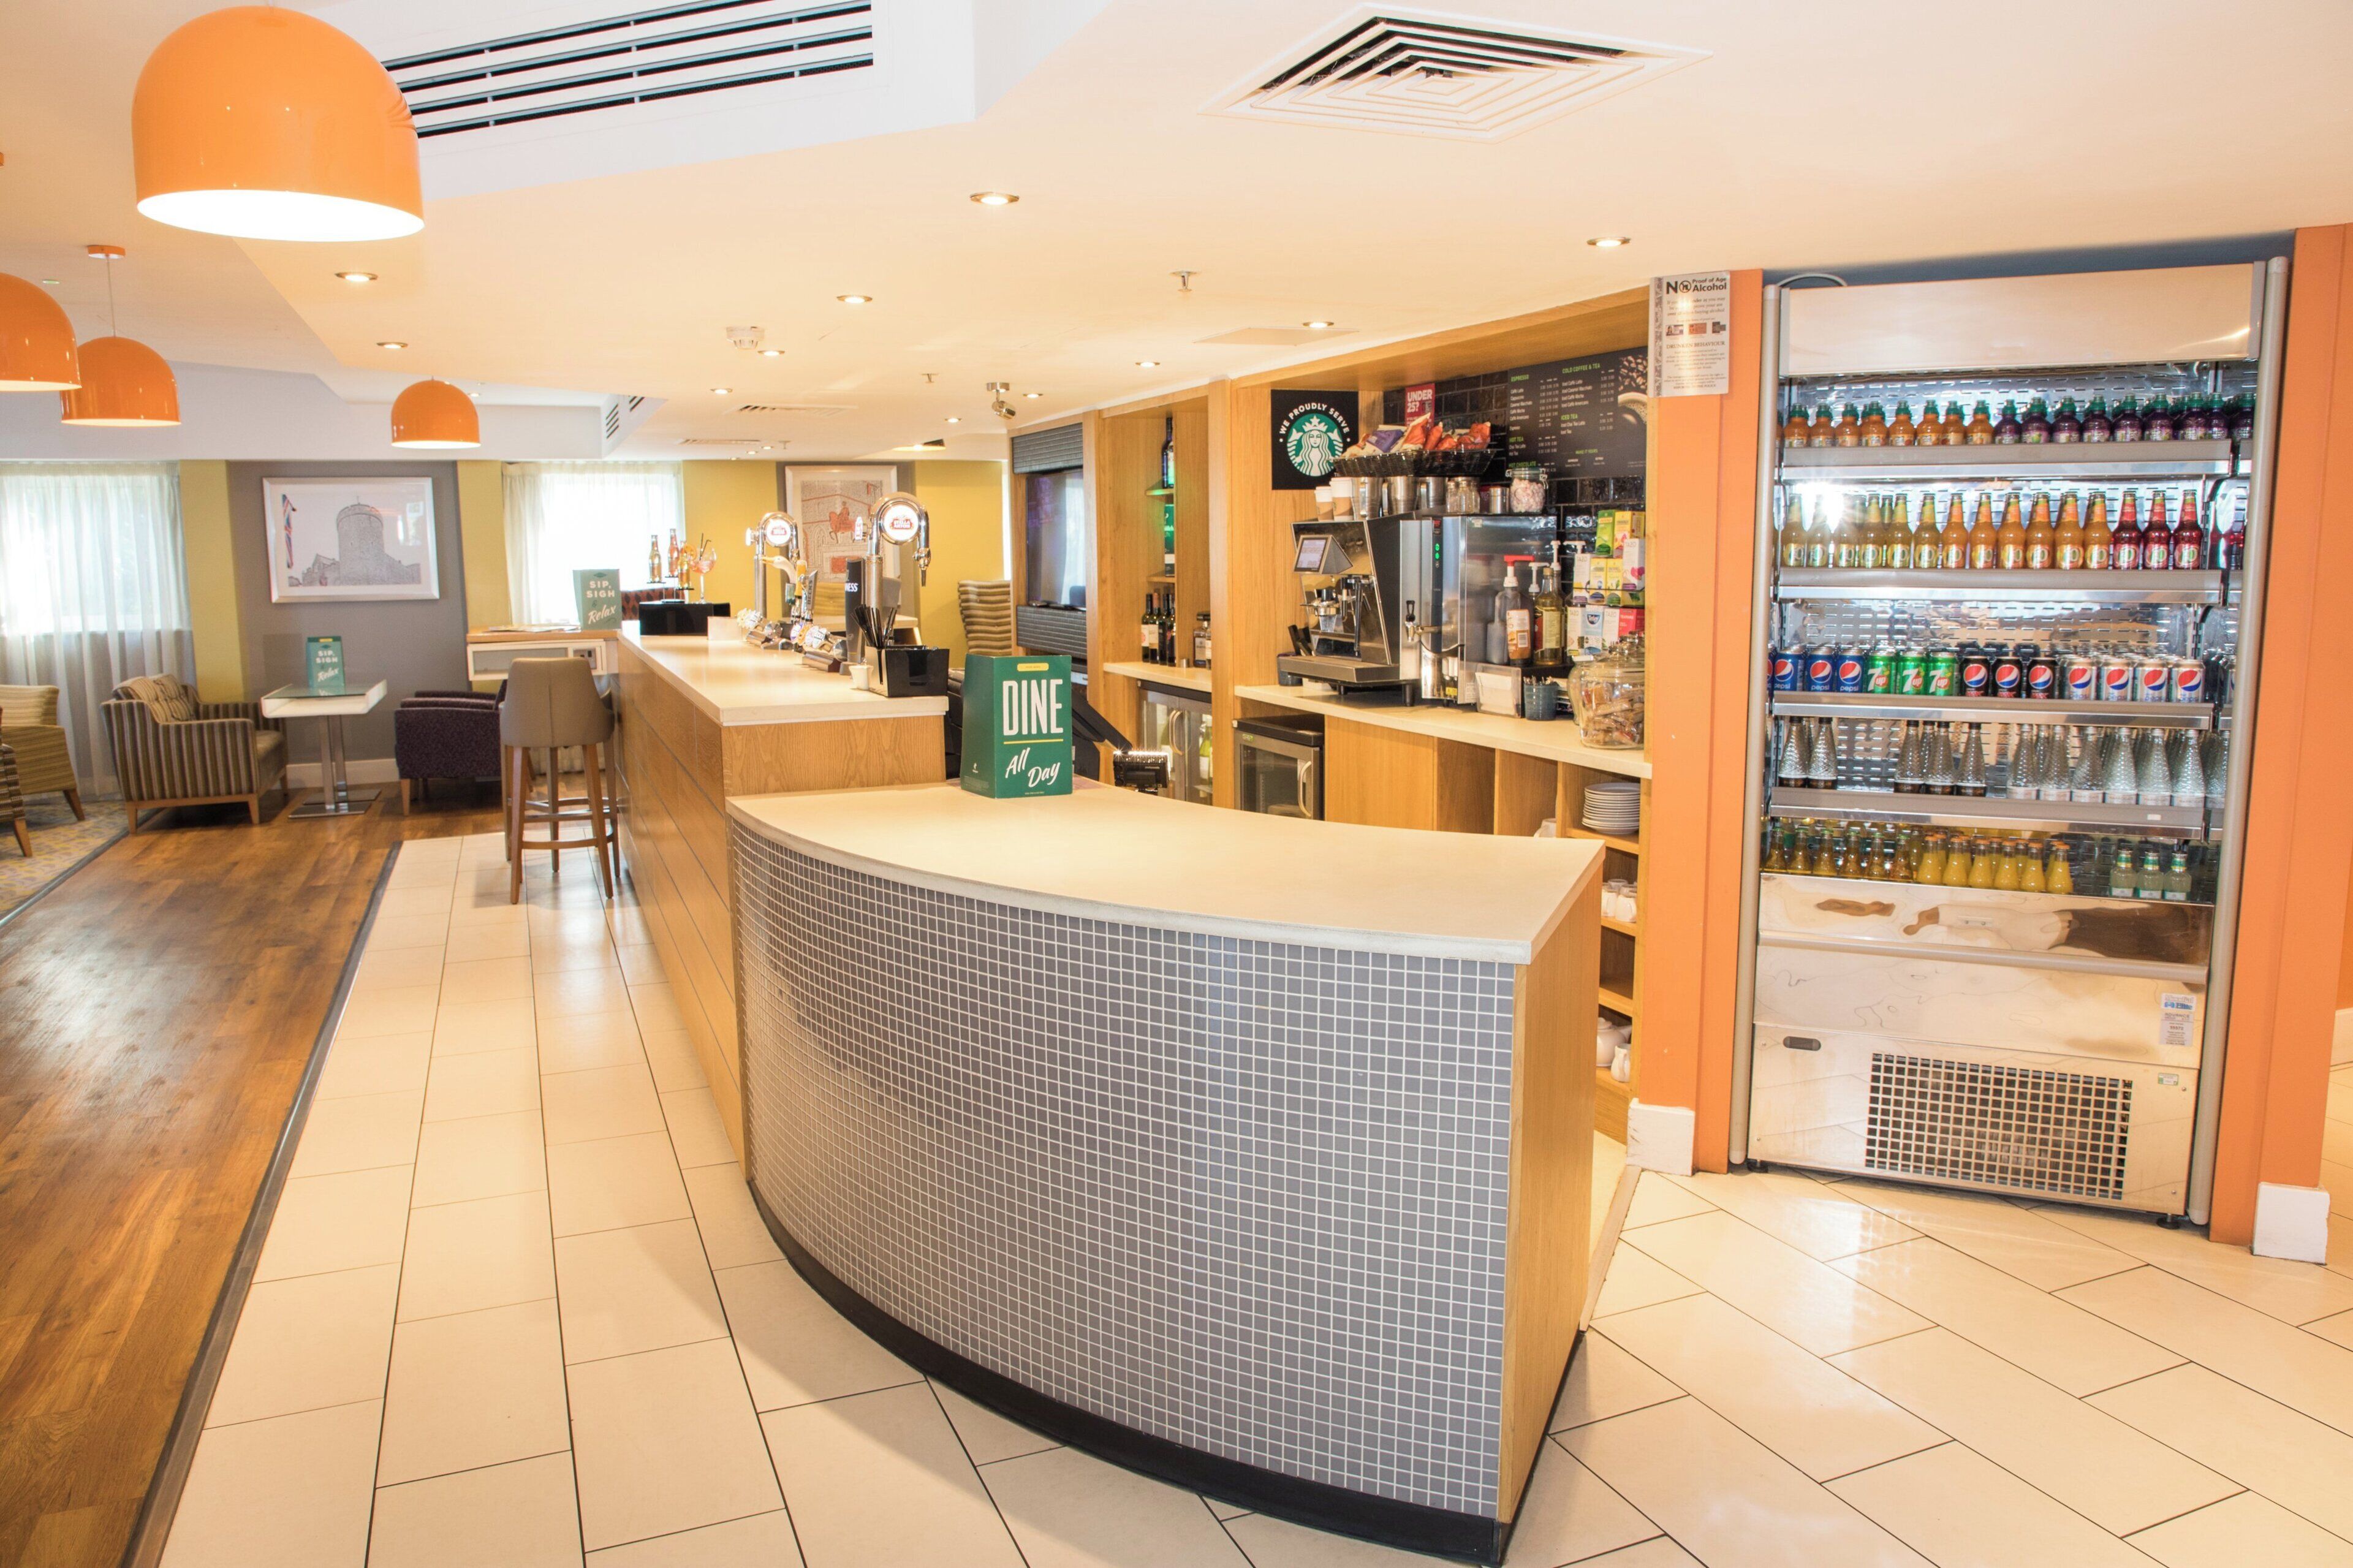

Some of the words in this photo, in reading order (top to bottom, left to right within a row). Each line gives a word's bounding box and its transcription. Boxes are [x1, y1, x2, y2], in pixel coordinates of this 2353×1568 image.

[1692, 282, 1727, 292] Alcohol
[1408, 389, 1433, 403] UNDER
[1407, 401, 1420, 412] 25?
[1279, 420, 1290, 434] WE
[1288, 403, 1327, 420] PROUDLY
[1329, 408, 1350, 433] SERVE
[588, 604, 616, 624] Relax
[317, 667, 339, 682] Relax
[1002, 679, 1063, 736] DINE
[1005, 747, 1031, 779] All
[1028, 762, 1061, 787] Day
